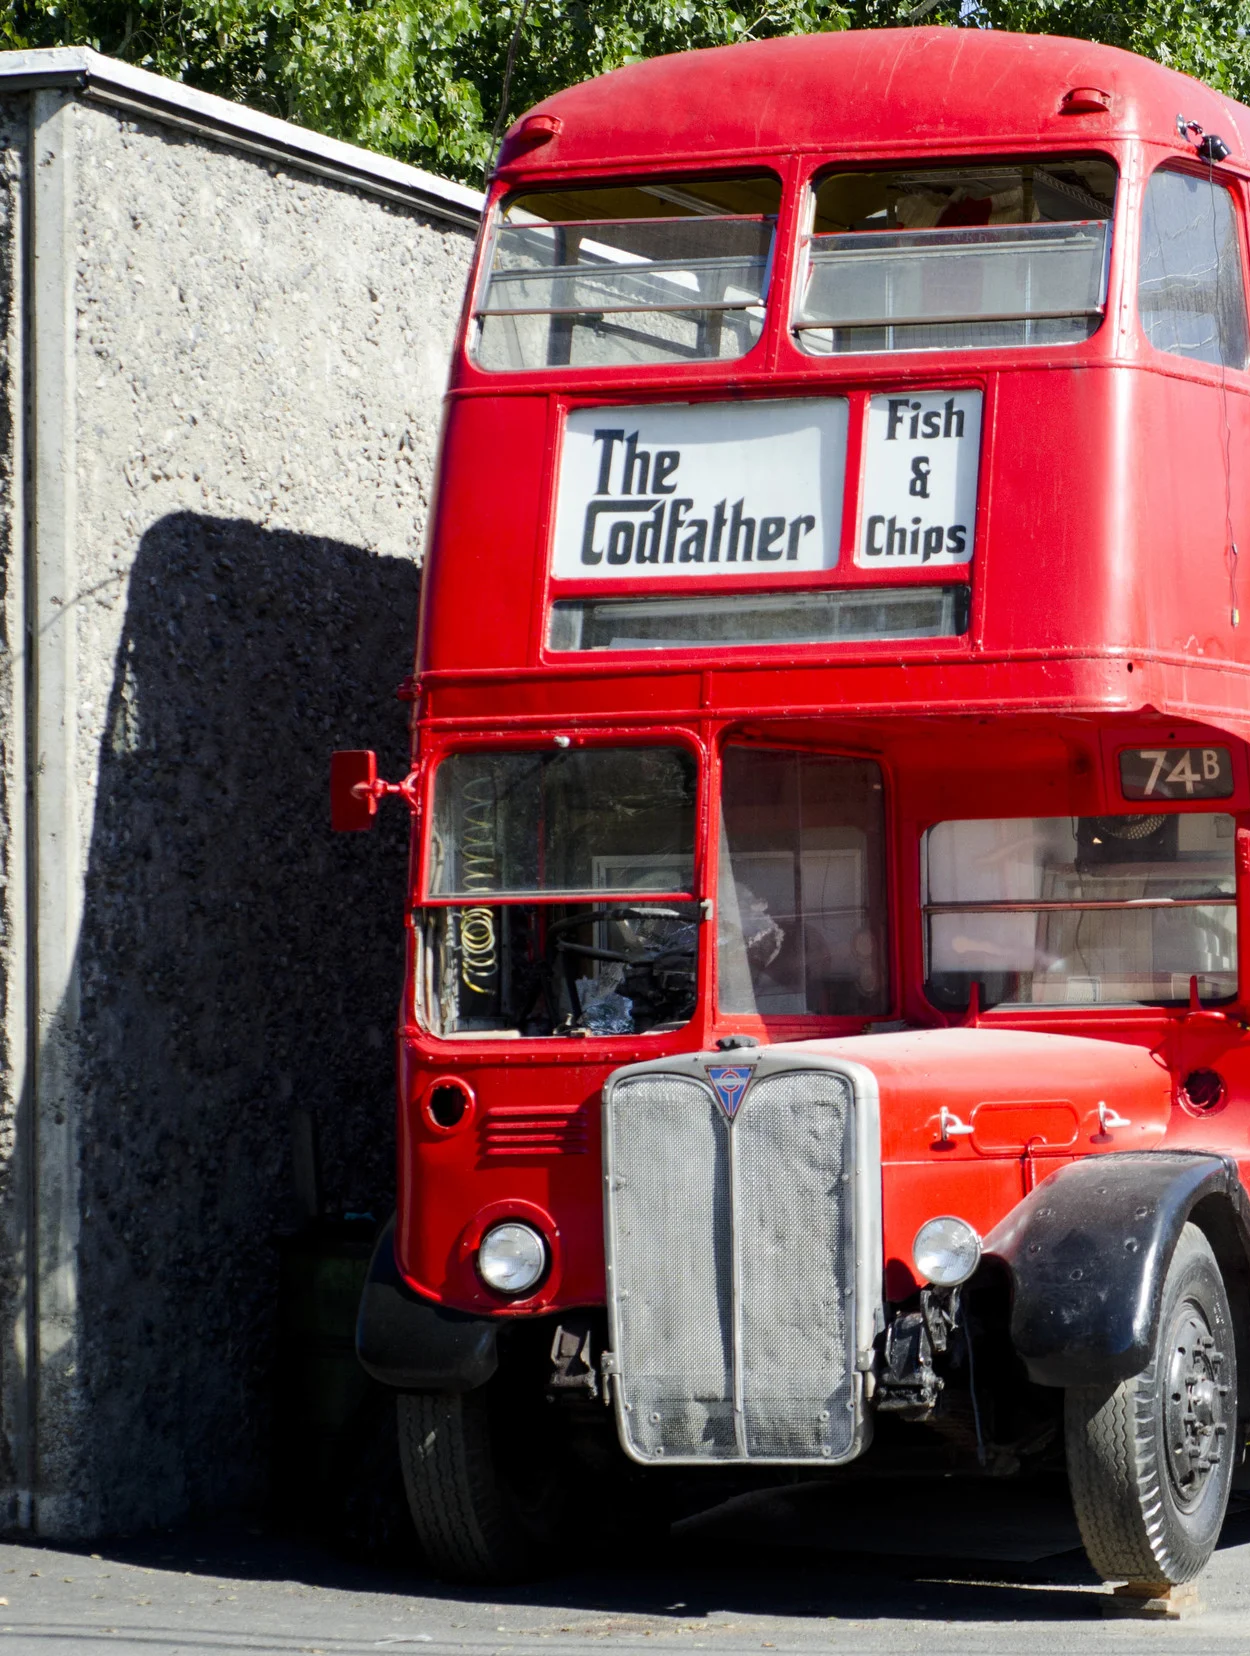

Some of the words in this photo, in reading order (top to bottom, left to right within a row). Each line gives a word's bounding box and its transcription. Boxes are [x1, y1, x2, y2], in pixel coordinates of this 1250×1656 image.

[885, 397, 965, 442] Fish
[593, 429, 681, 496] The
[909, 455, 931, 499] &
[581, 497, 816, 566] Codfather
[866, 514, 967, 564] Chips
